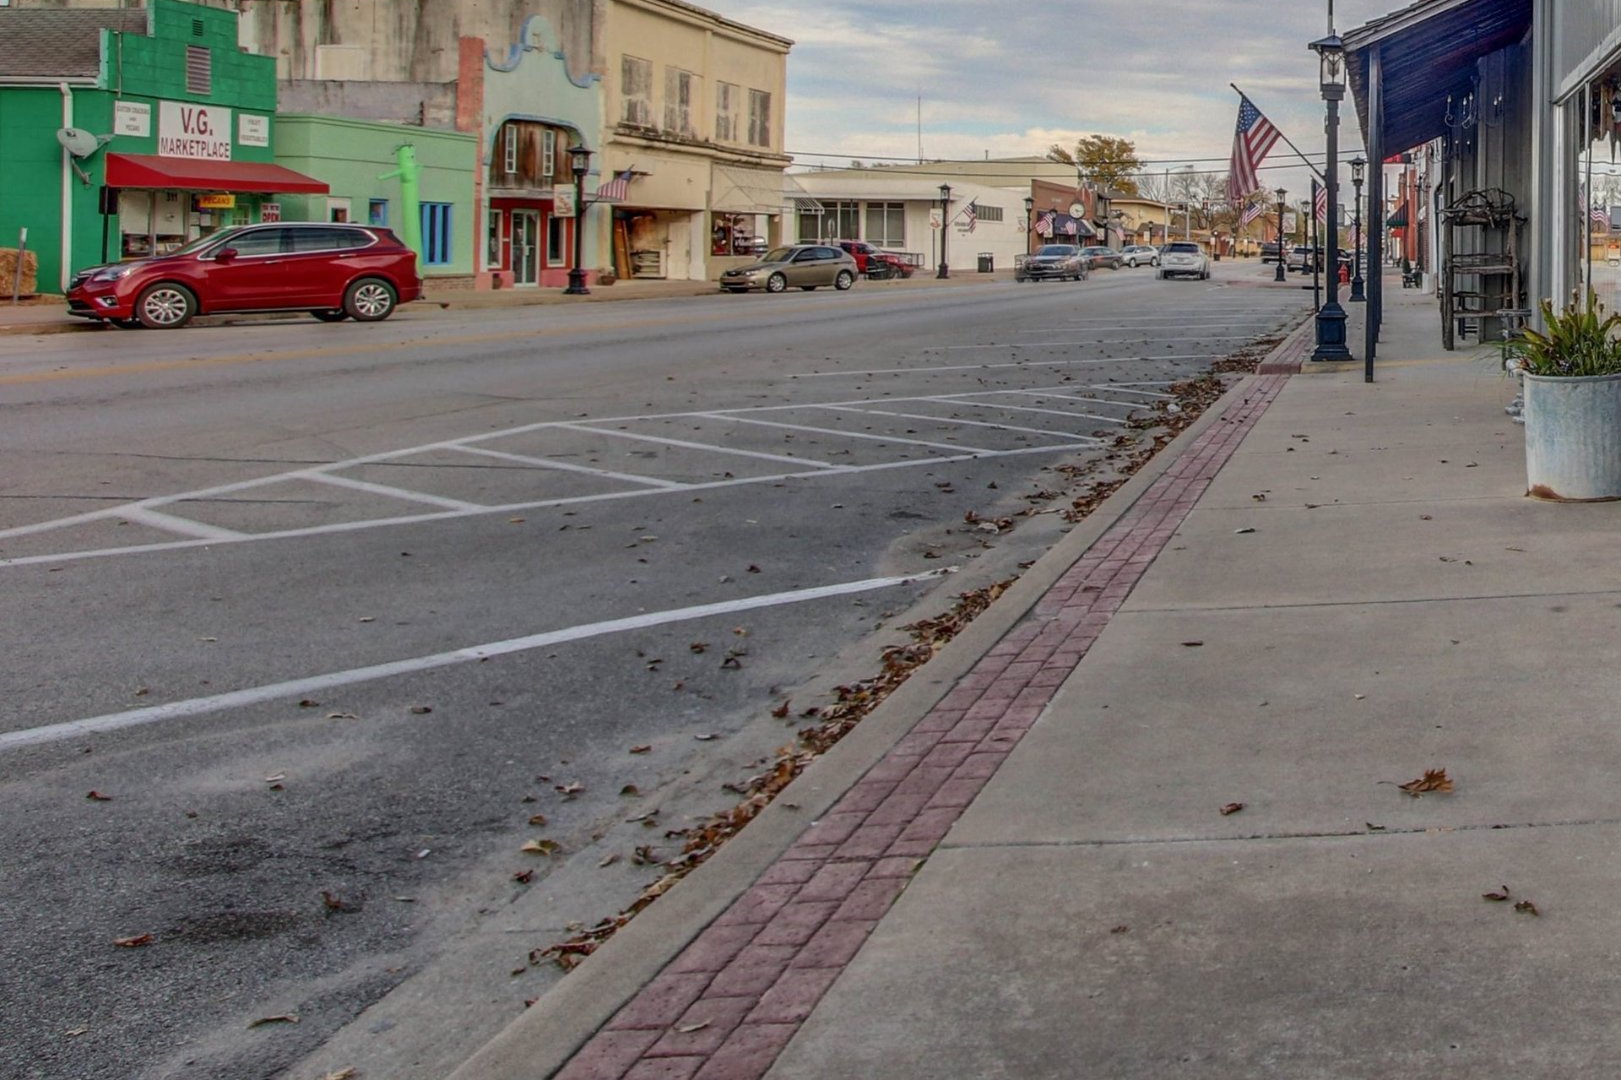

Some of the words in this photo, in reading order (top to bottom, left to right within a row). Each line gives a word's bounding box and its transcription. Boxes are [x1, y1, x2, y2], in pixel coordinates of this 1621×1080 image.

[181, 107, 213, 136] V.G.
[160, 137, 230, 159] MARKETPLACE
[262, 212, 279, 223] OPEN
